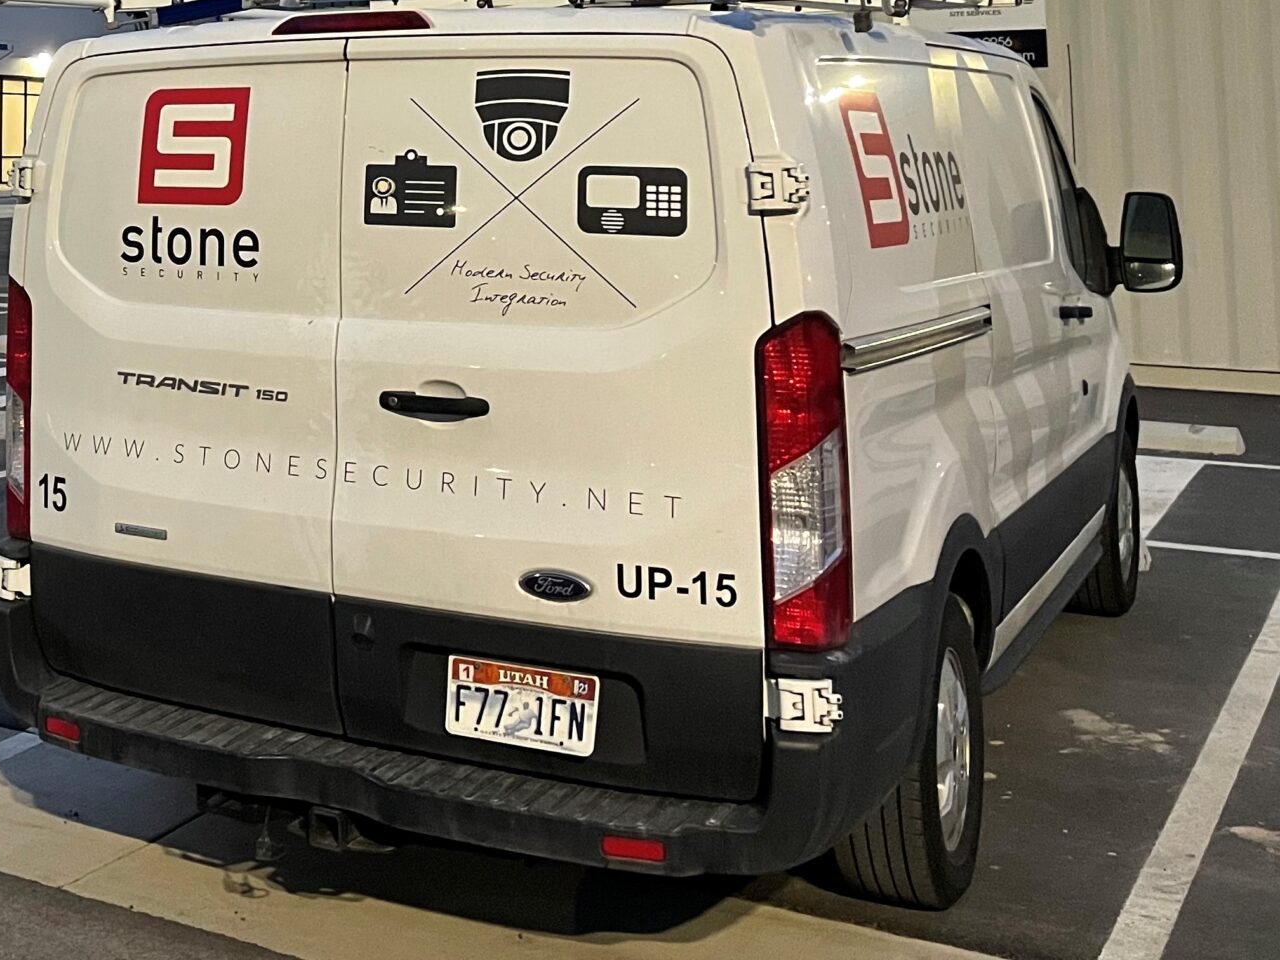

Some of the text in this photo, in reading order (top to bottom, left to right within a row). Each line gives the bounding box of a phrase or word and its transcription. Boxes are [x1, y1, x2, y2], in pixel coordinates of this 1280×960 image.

[966, 9, 1002, 17] SERVICES
[899, 133, 965, 216] stone
[120, 215, 260, 268] stone
[912, 215, 971, 240] SECURITY
[122, 266, 259, 283] SECURITY
[450, 259, 587, 292] Modern Security
[470, 282, 566, 316] Integration
[117, 370, 289, 402] TRANSIT 150
[63, 431, 683, 519] WWW.STONESECURITY.NET
[38, 472, 68, 513] 15
[533, 576, 575, 596] Ford
[616, 562, 739, 608] UP-15
[498, 669, 549, 689] UTAH
[454, 683, 509, 729] F77
[533, 696, 586, 742] 1FN
